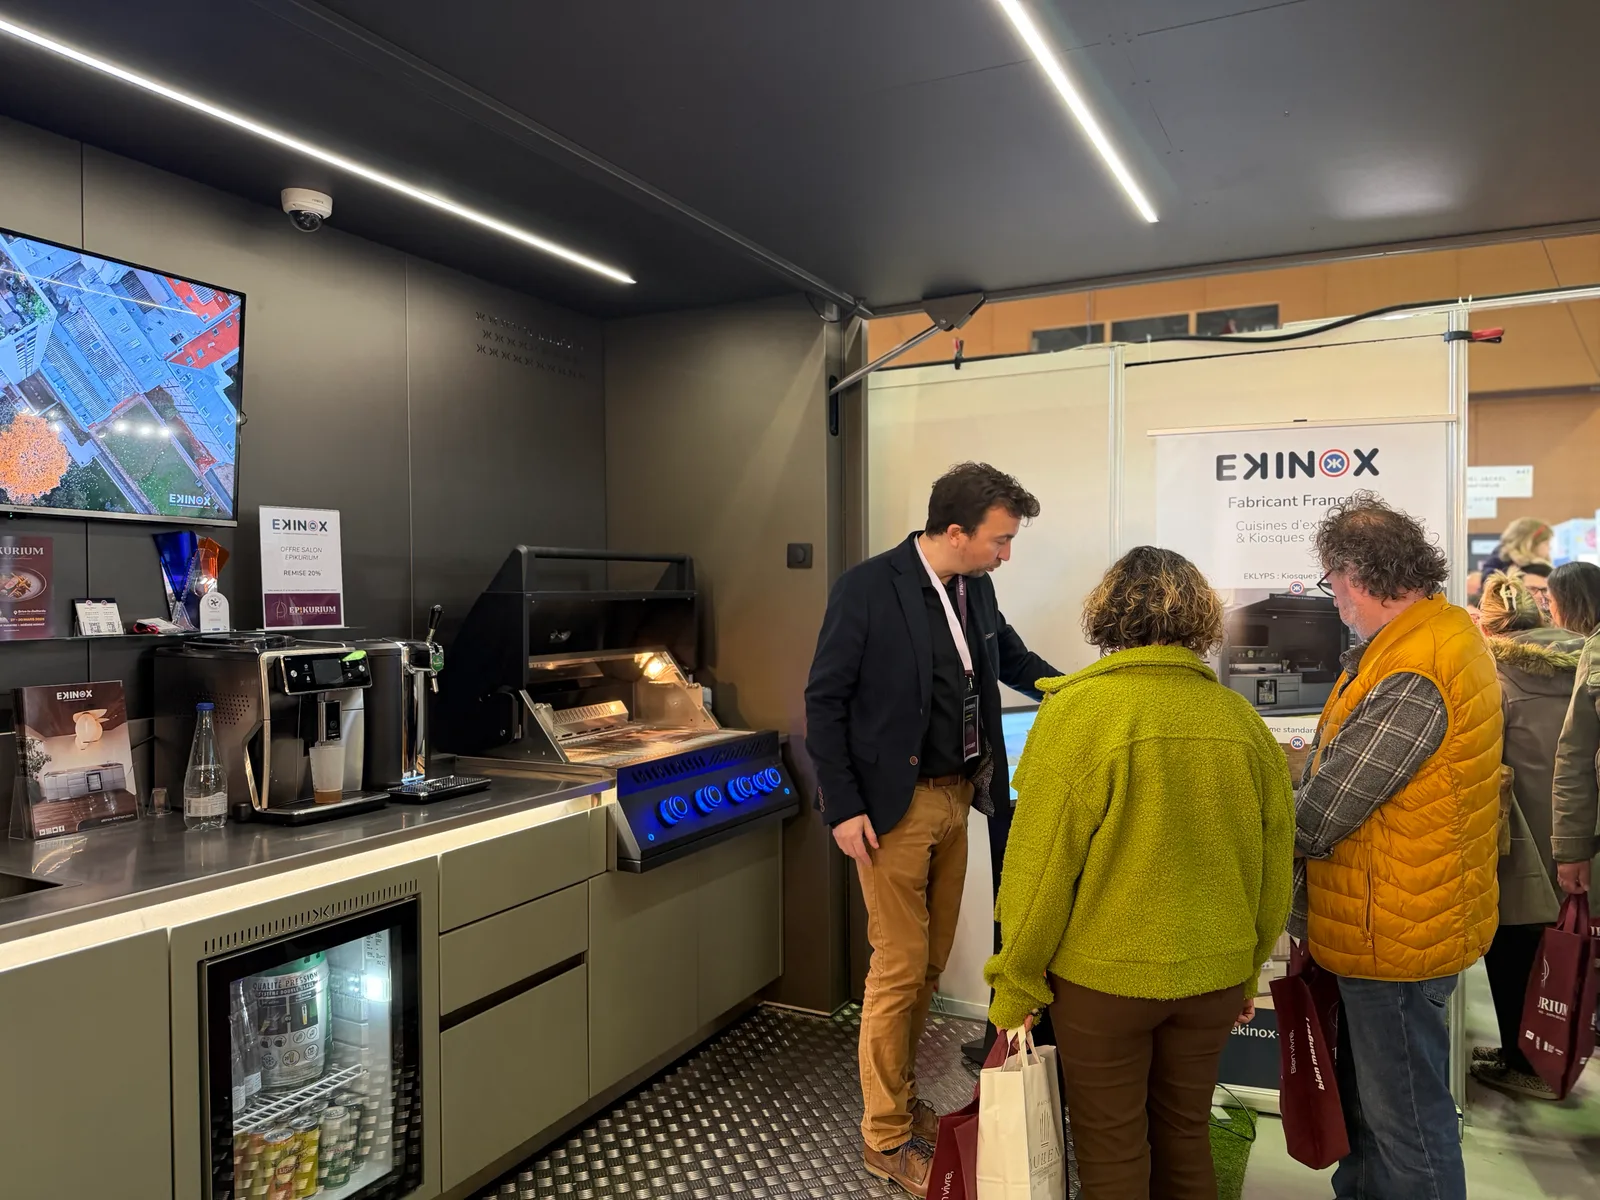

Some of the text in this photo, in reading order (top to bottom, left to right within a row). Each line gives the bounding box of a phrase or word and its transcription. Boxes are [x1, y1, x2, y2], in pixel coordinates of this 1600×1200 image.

[1216, 448, 1380, 481] EKINOX
[169, 493, 211, 506] EKINOX
[1228, 496, 1299, 509] Fabricant
[272, 518, 328, 533] EKINOX
[1236, 520, 1288, 531] Cuisines
[1236, 533, 1245, 543] &
[1249, 532, 1305, 545] Kiosques
[1243, 572, 1276, 580] EKLYPS
[1281, 572, 1318, 581] Kiosques
[56, 689, 93, 700] EKINOX
[285, 971, 319, 987] PRESSION
[1230, 1023, 1280, 1039] ekinox-
[1288, 1029, 1296, 1053] vivre,
[1306, 1022, 1318, 1066] manger
[1314, 1067, 1325, 1091] bien
